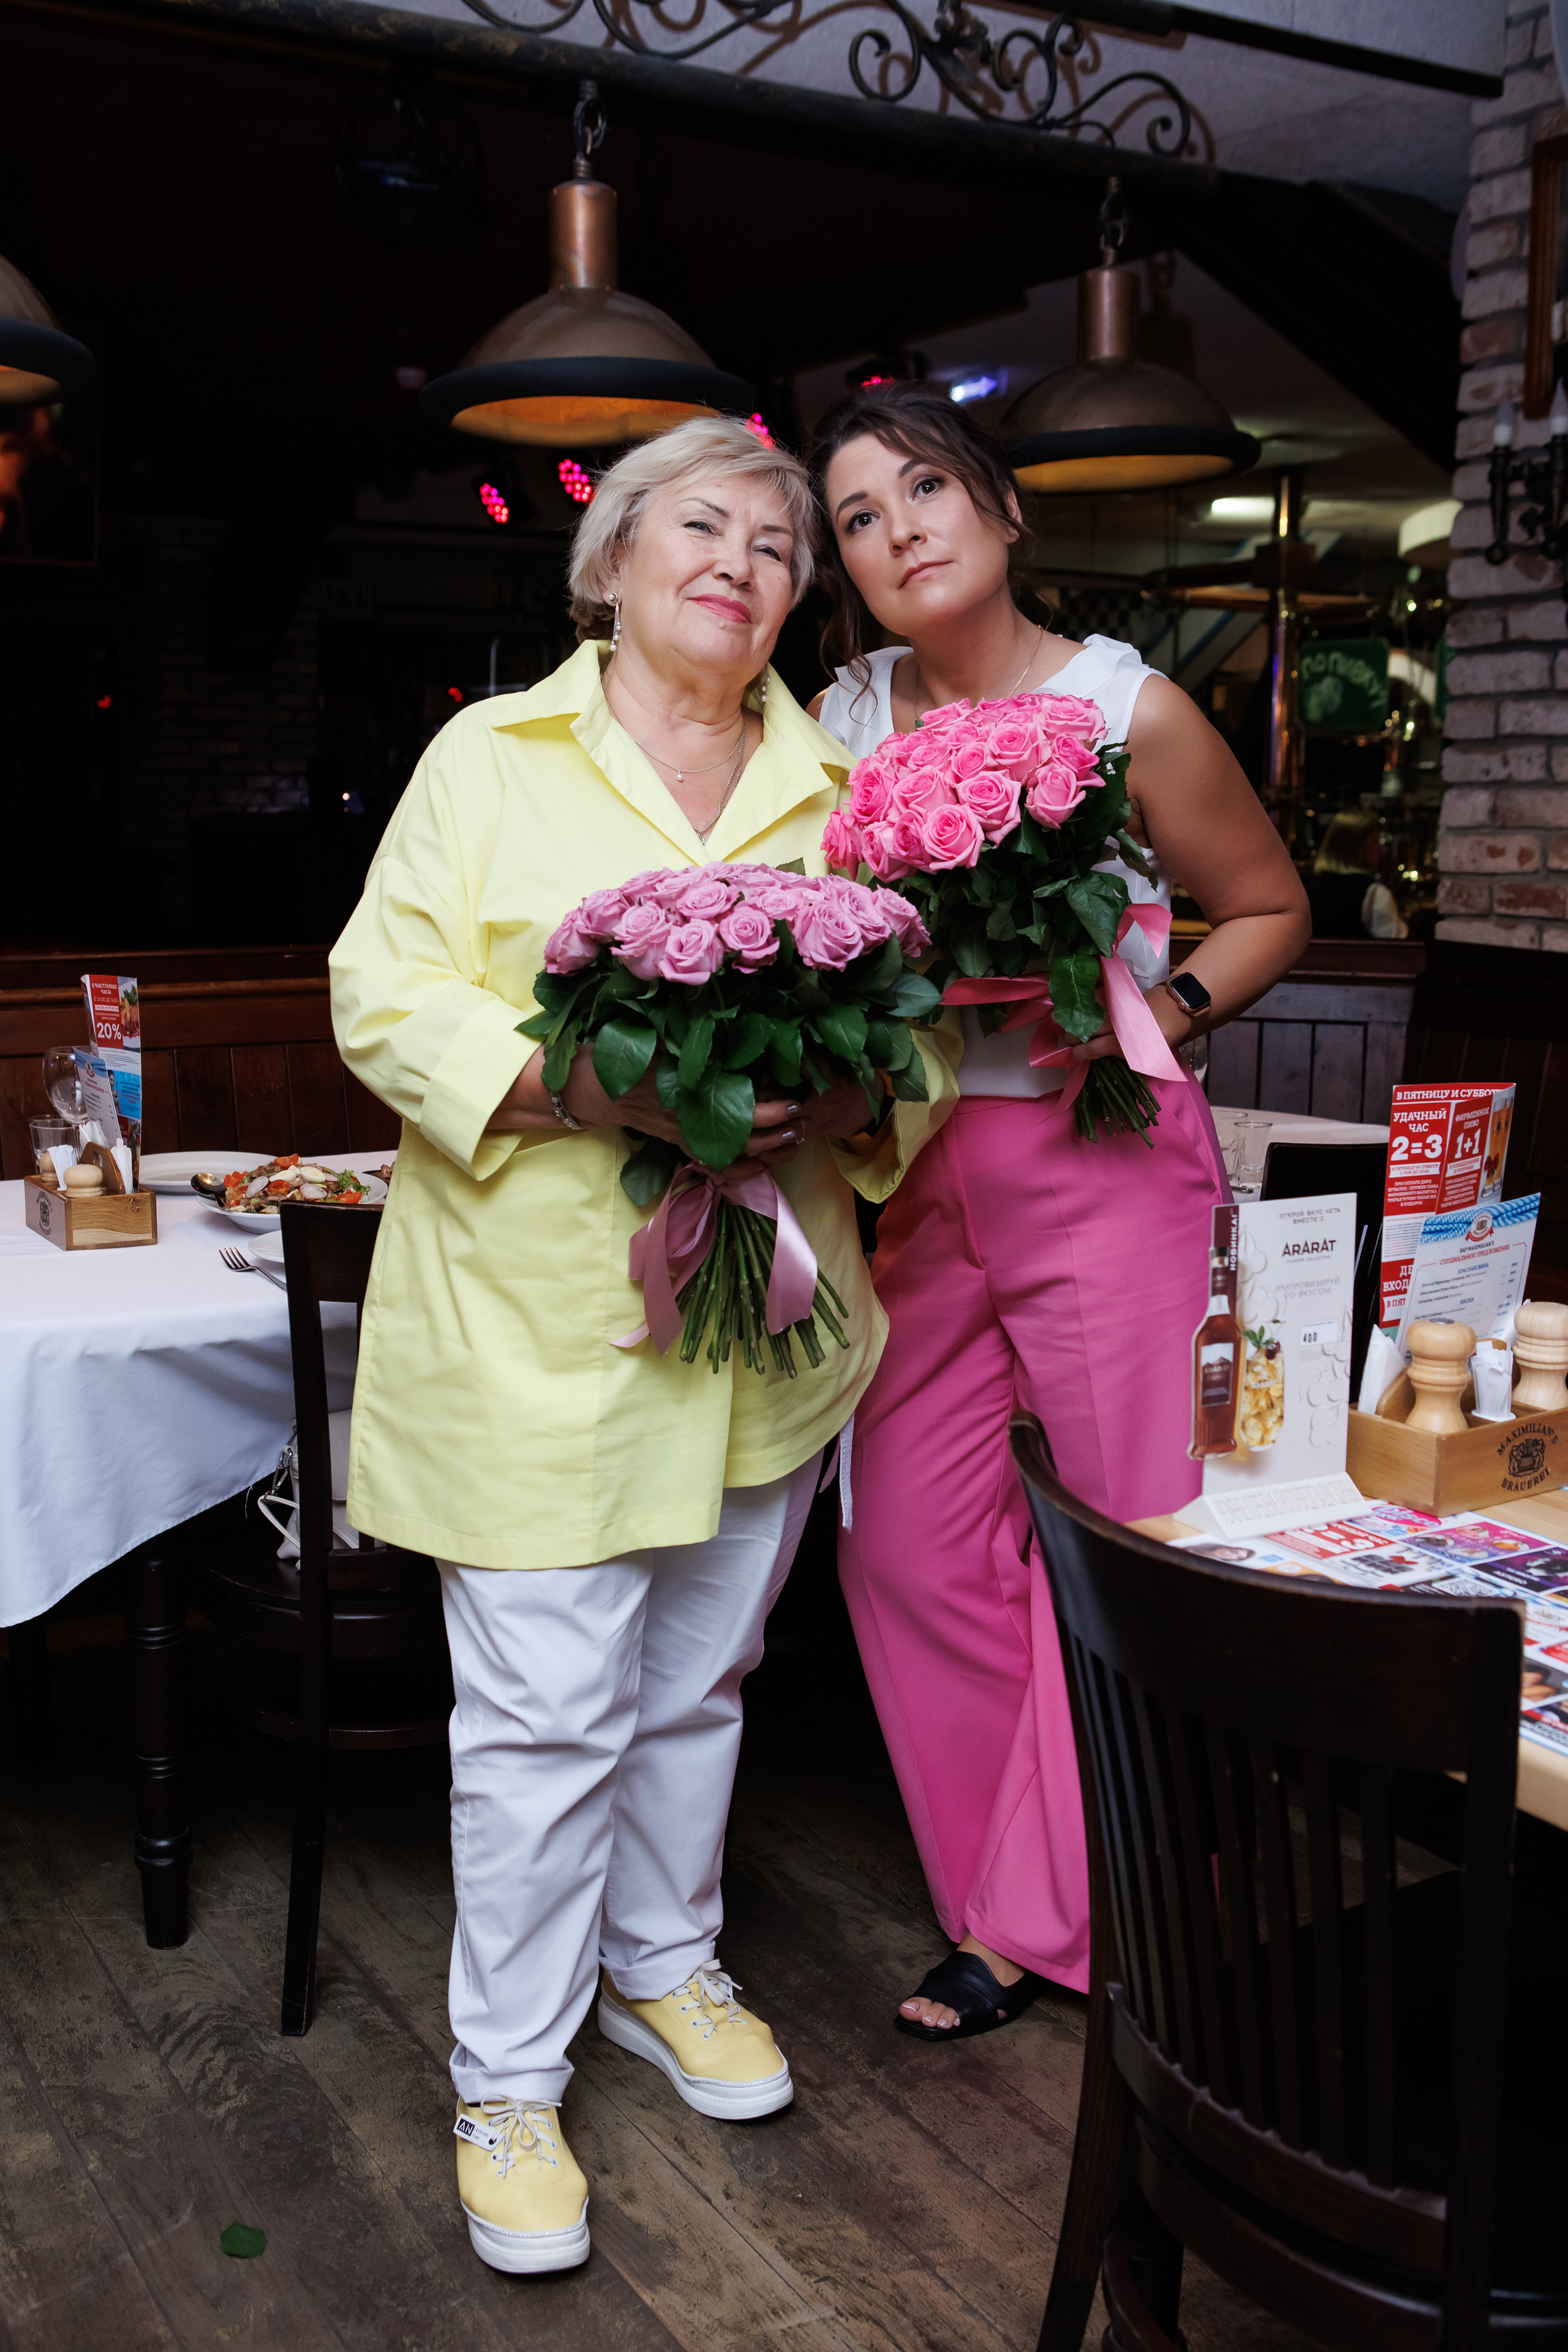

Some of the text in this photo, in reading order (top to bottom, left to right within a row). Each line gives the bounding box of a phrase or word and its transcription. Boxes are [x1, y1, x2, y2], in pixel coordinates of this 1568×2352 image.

[97, 1022, 121, 1040] 20%
[1403, 1090, 1450, 1100] ПЯТНИЦУ
[1393, 1108, 1447, 1123] УДАЧНЫЙ
[1455, 1107, 1490, 1121] ФИРМЕННОЕ
[1409, 1123, 1429, 1133] ЧАС
[1464, 1119, 1479, 1129] ПИВО
[1390, 1134, 1442, 1161] 2=3
[1455, 1128, 1480, 1159] 1+1
[1279, 1210, 1304, 1219] ОТКРОЙ
[1229, 1214, 1238, 1271] НОВИНКА!
[1282, 1238, 1336, 1257] ARARAT
[1440, 1244, 1510, 1265] СПЕЦИАЛЬНОЕ ПРЕДЛОЖЕНИЕ
[1276, 1276, 1340, 1292] ИМПРОВИЗИРУЙ
[1299, 1287, 1331, 1297] ВКУСОМ
[1303, 1332, 1317, 1343] 400
[1497, 1423, 1558, 1456] MAXIMILIAN'S
[1501, 1468, 1550, 1491] BRAUEREI
[474, 2127, 489, 2138] LEISURE
